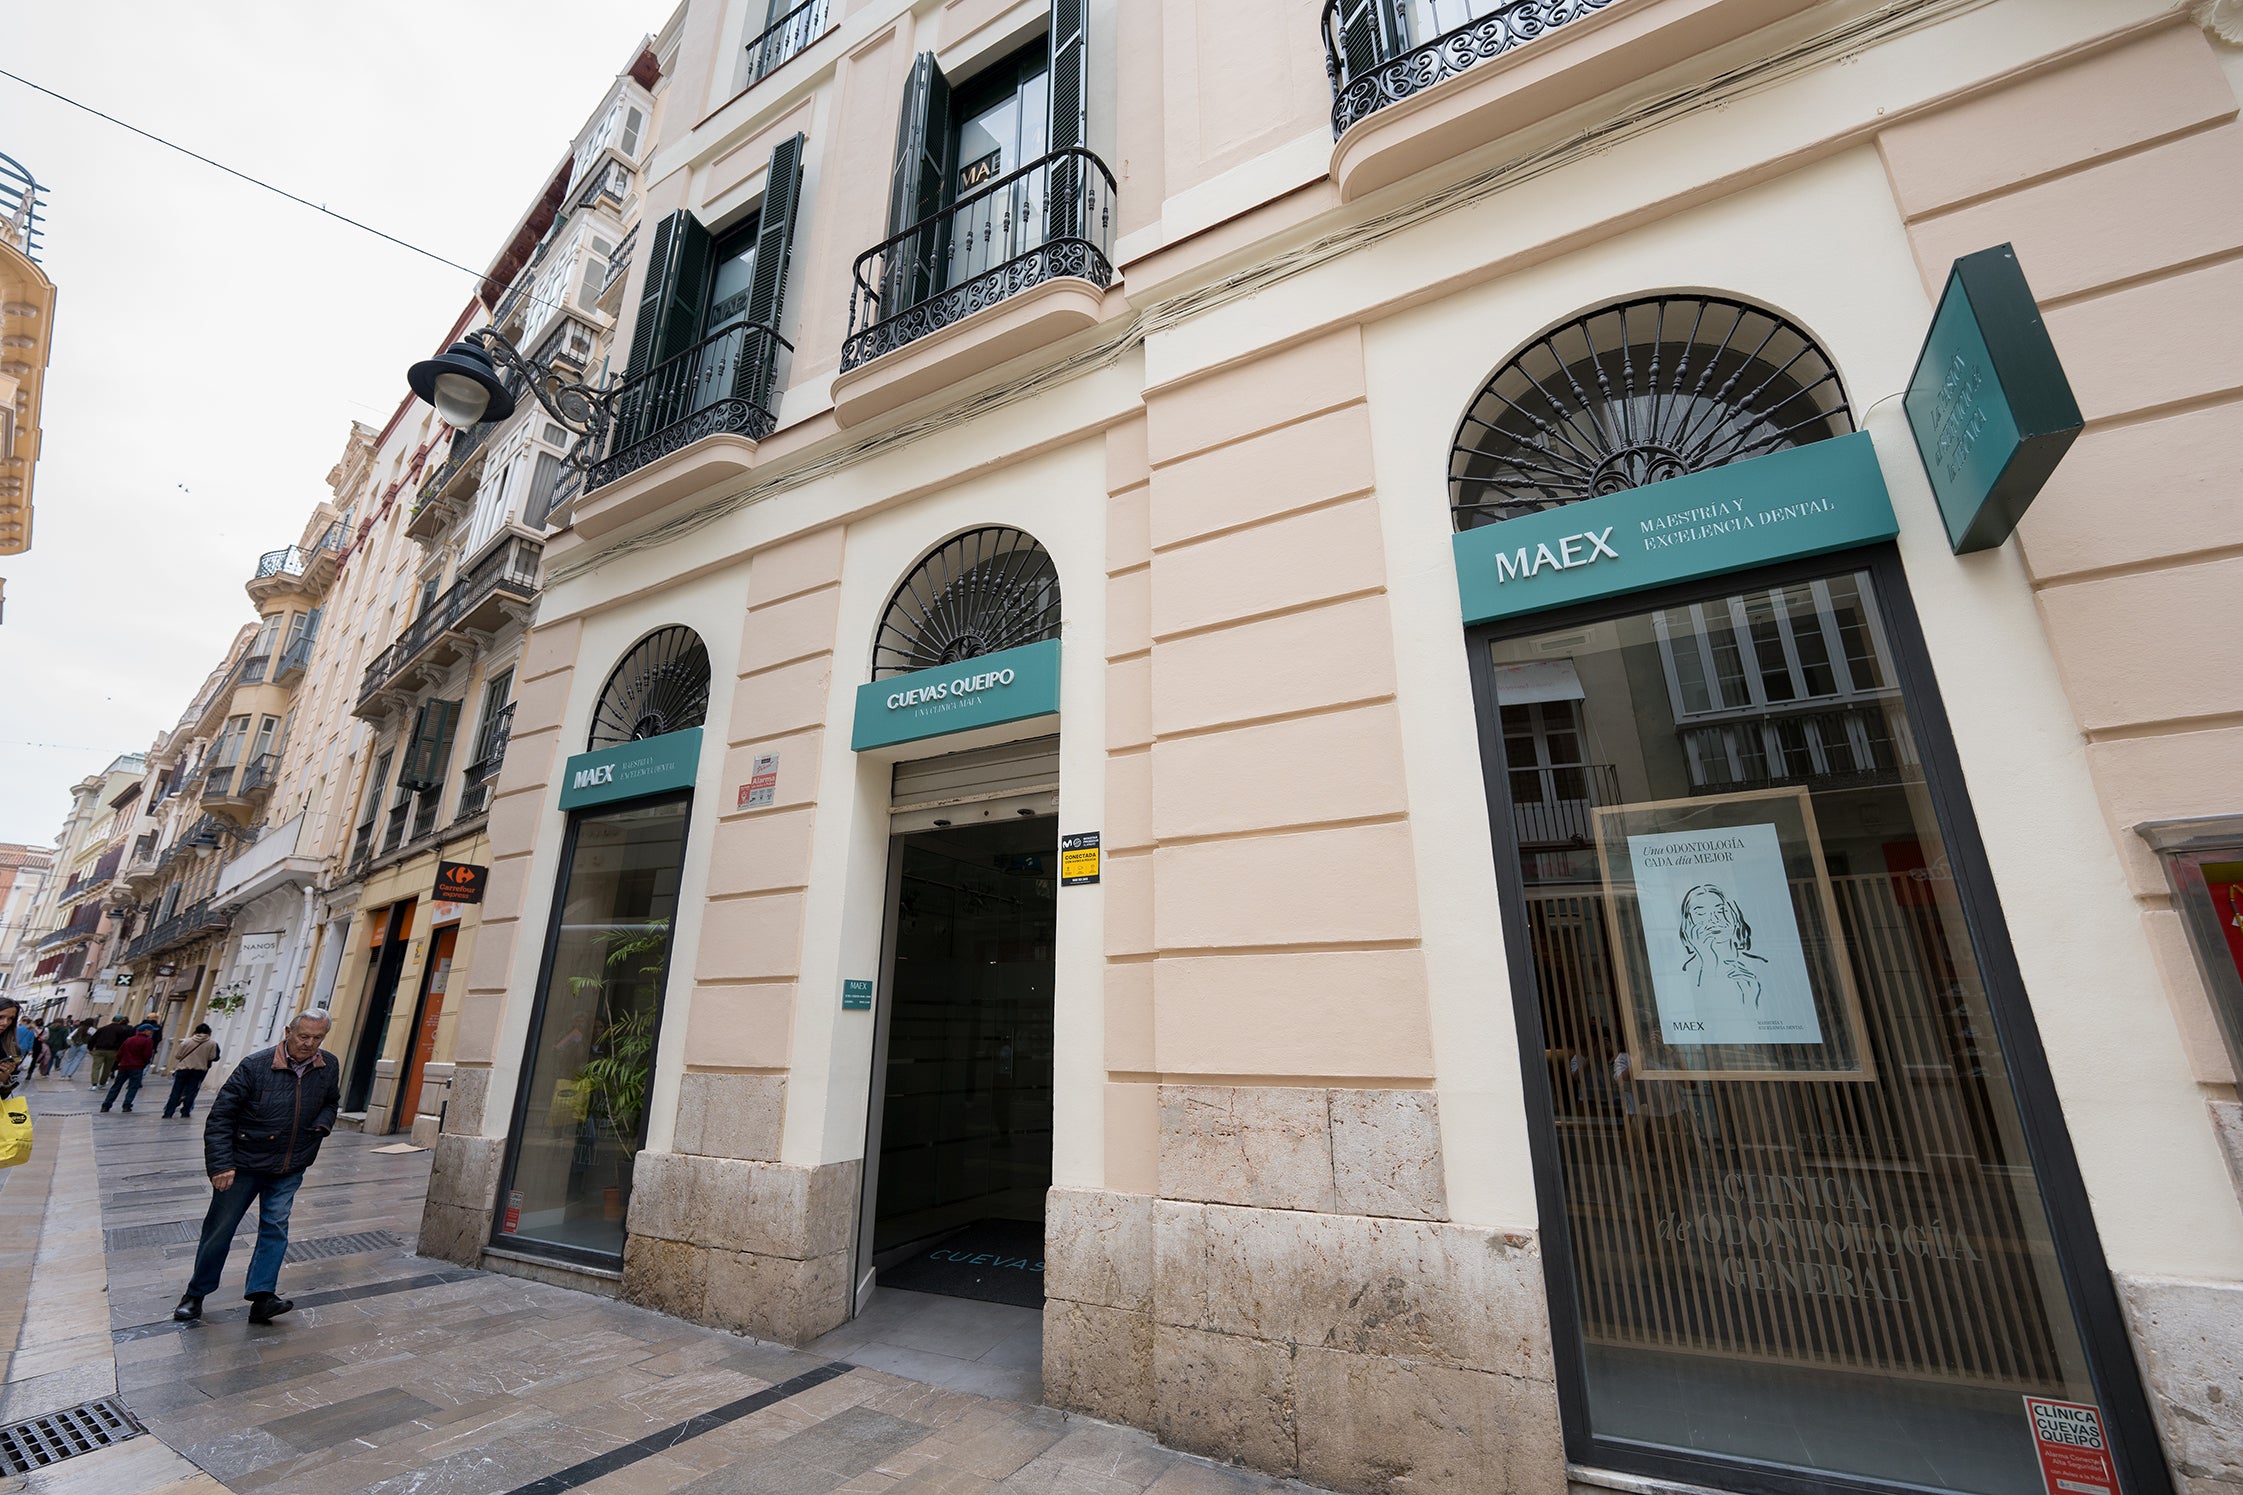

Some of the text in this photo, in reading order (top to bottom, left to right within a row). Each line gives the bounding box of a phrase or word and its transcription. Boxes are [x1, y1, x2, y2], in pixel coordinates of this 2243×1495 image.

[1639, 498, 1745, 534] MAESTRÍA Y
[1495, 498, 1836, 583] MAEX EXCELENCIA DENTAL
[886, 668, 1015, 711] CUEVAS QUEIPO
[573, 763, 615, 790] MAEX
[1065, 852, 1096, 860] CONECTADA
[1643, 837, 1745, 856] Una ODONTOLOGÍA
[1644, 852, 1734, 868] CADA día MEJOR
[439, 883, 476, 893] Carrefour
[850, 981, 867, 990] MAEX
[1672, 1021, 1705, 1031] MAEX
[1655, 1208, 1983, 1263] de ODONTOLOGÍA
[930, 1249, 1045, 1272] CUEVAS
[1722, 1255, 1914, 1303] GENERAL
[2034, 1404, 2097, 1424] CLÍNICA
[2037, 1418, 2100, 1438] CUEVAS
[2041, 1430, 2101, 1448] QUEIPO
